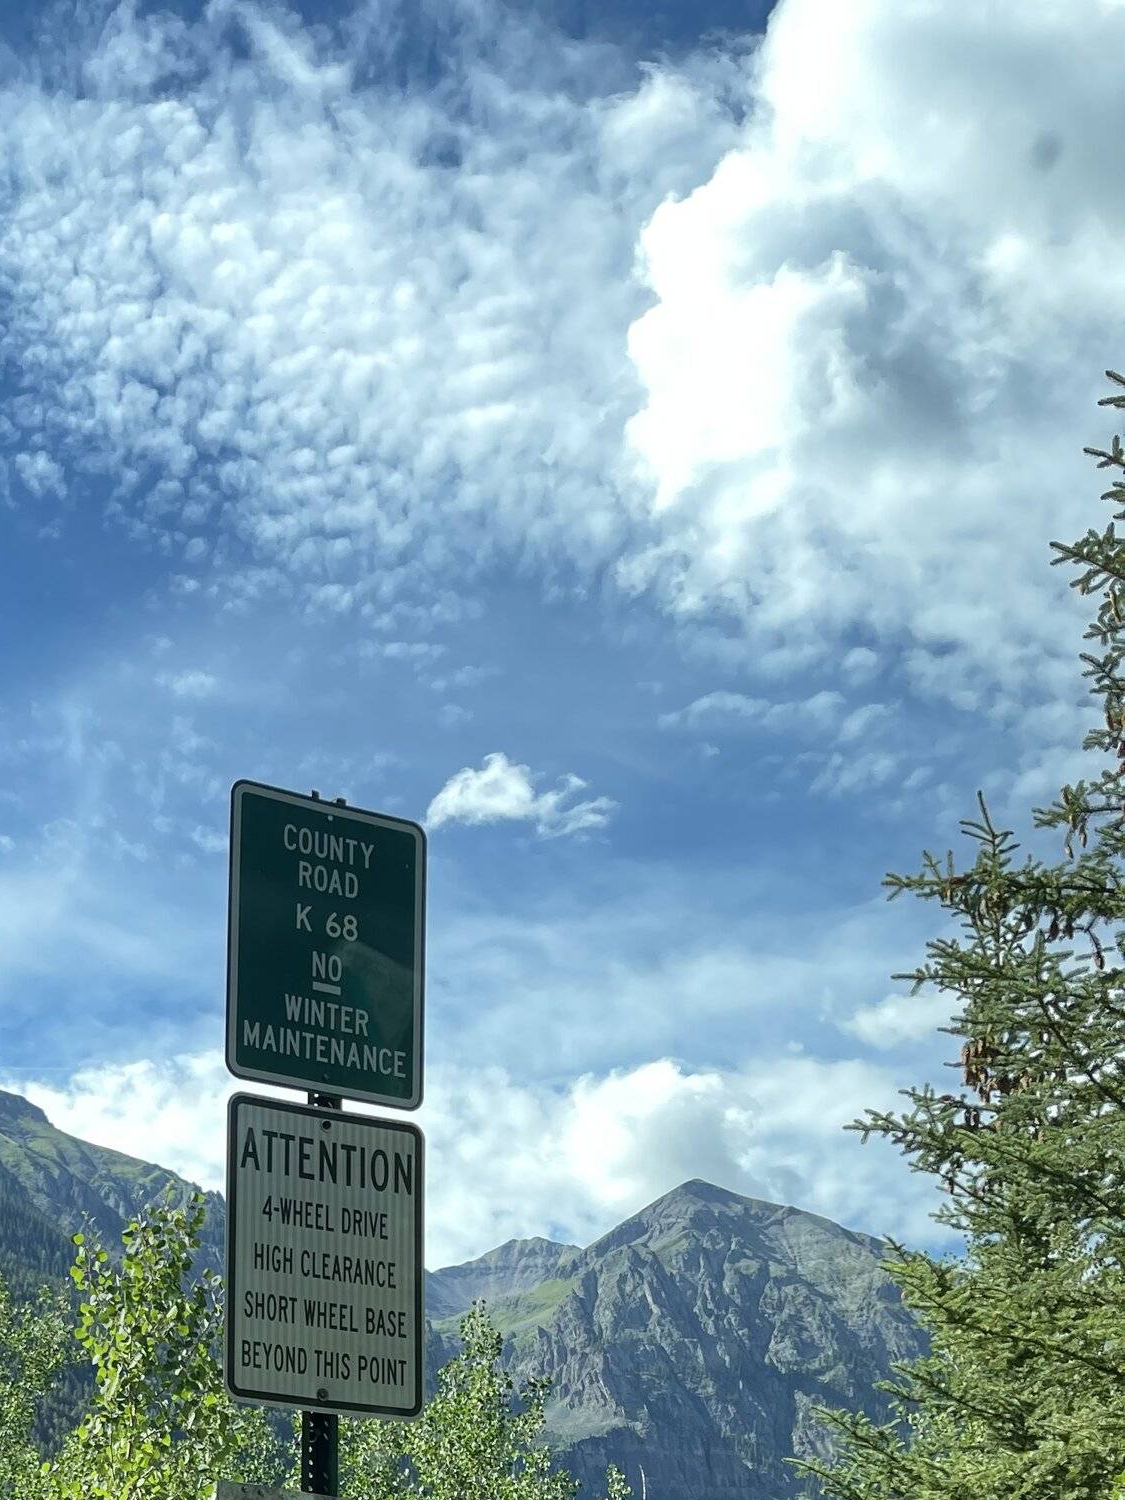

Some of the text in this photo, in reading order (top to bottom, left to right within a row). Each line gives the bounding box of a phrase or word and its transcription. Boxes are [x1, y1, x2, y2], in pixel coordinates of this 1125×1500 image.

[283, 823, 374, 869] COUNTY
[298, 861, 359, 899] ROAD
[296, 903, 358, 942] K 68
[312, 950, 342, 982] NO
[284, 993, 369, 1037] WINTER
[243, 1019, 407, 1079] MAINTENANCE
[240, 1126, 413, 1196] ATTENTION
[262, 1195, 389, 1241] 4-WHEEL DRIVE
[254, 1242, 397, 1290] HIGH CLEARANCE
[244, 1290, 407, 1339] SHORT WHEEL BASE
[241, 1339, 407, 1386] BEYOND THIS POINT
